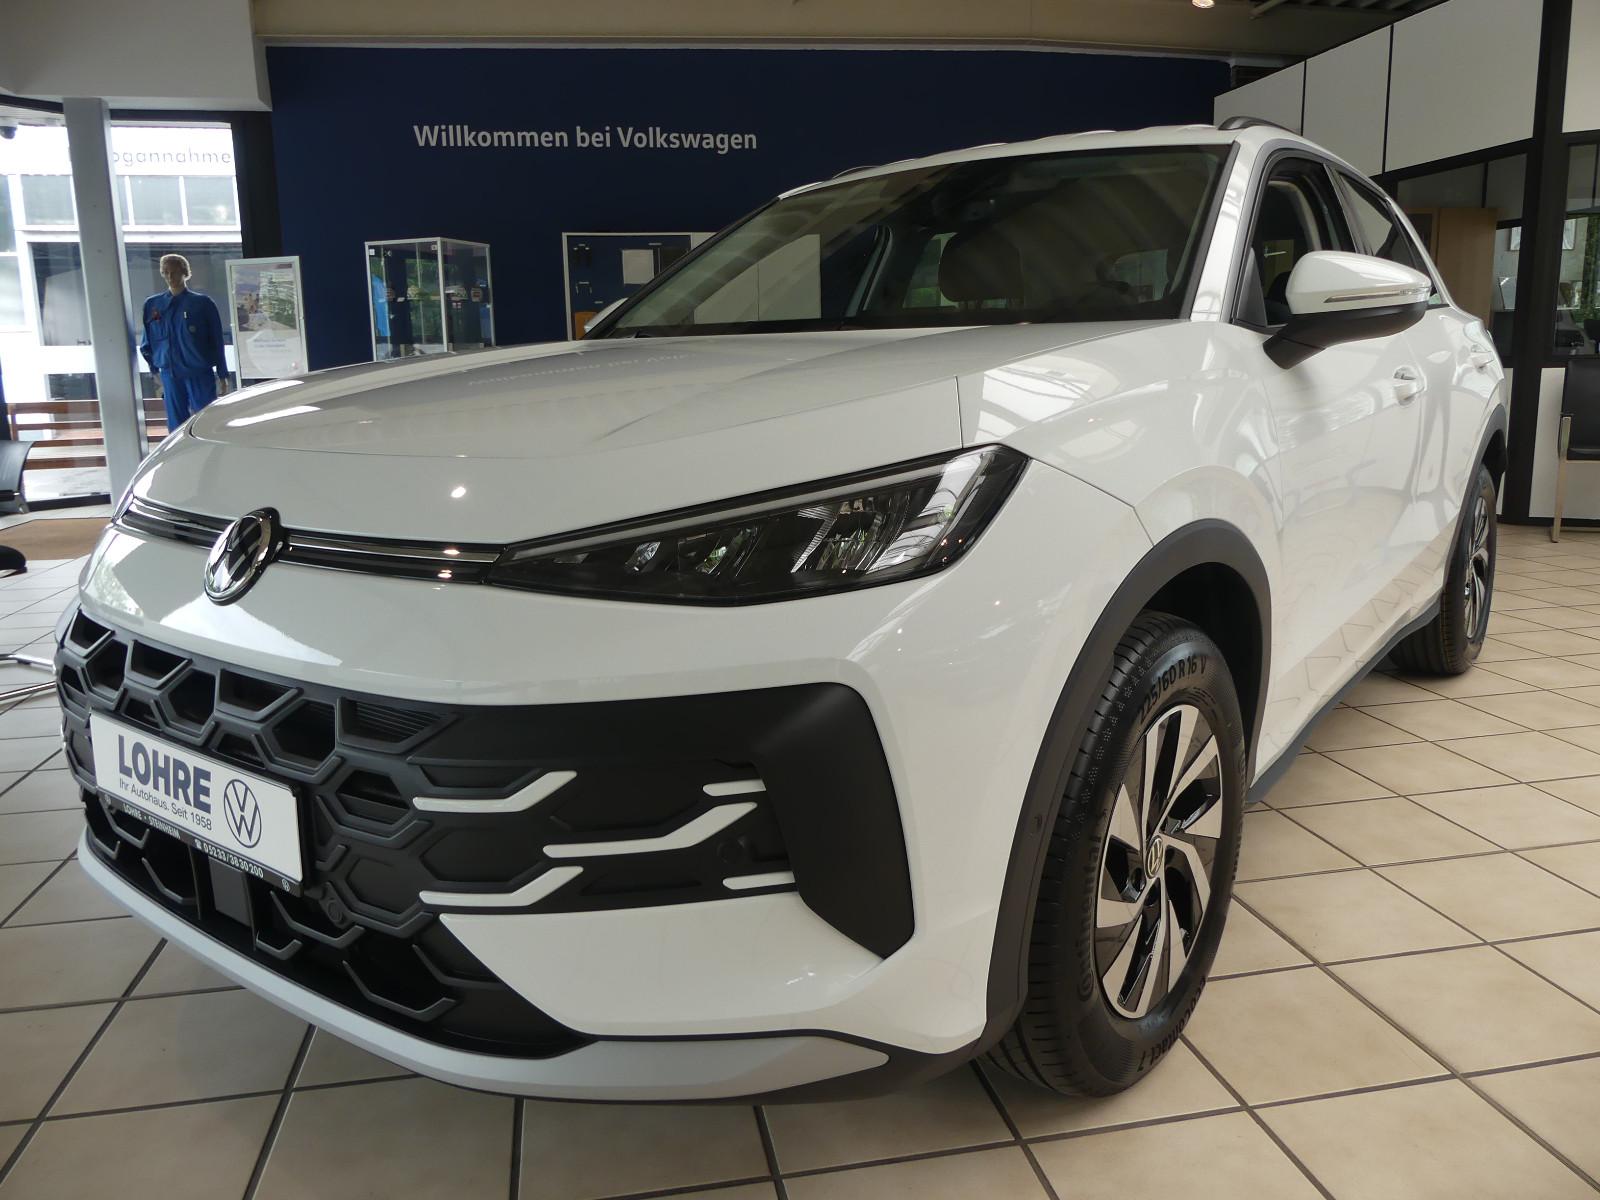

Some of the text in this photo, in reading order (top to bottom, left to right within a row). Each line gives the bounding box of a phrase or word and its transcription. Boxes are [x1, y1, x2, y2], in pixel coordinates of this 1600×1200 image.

[413, 125, 757, 155] Willkommen bei Volkswagen
[118, 734, 211, 815] LOHRE
[119, 777, 213, 831] Ihr Autohaus. Seit 1958
